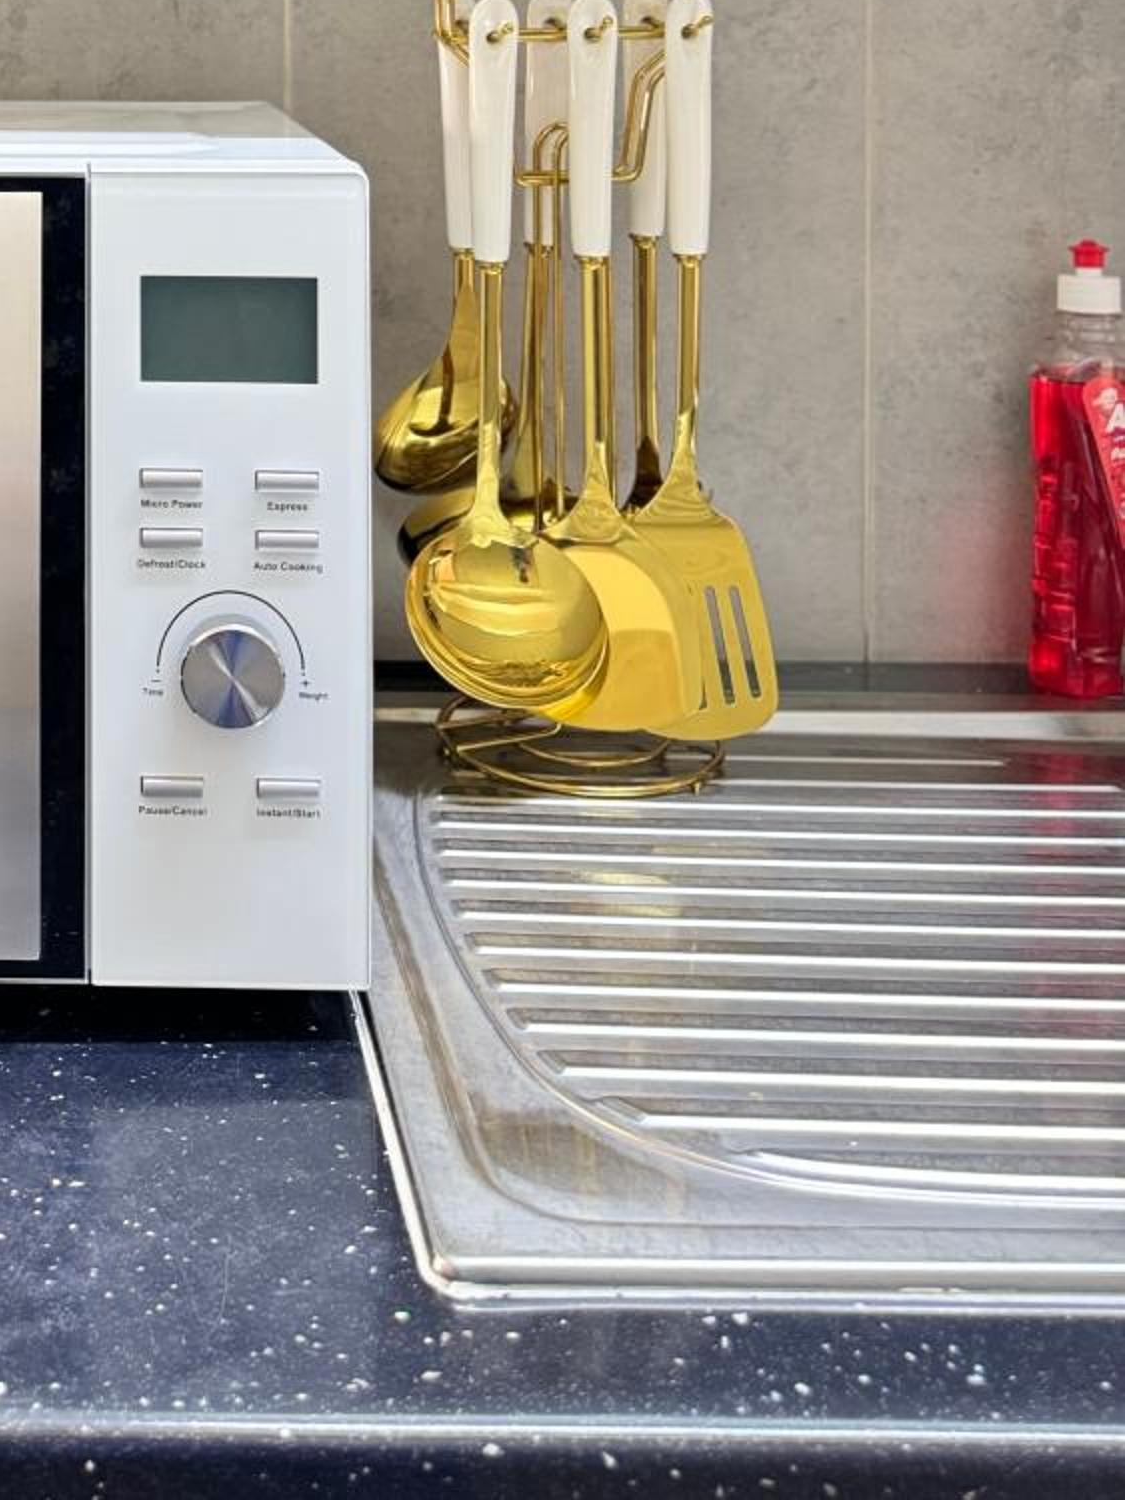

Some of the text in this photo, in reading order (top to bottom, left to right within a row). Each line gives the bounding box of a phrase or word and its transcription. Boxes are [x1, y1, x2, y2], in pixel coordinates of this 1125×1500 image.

[140, 499, 203, 510] Micro Power
[267, 502, 308, 512] Express
[253, 561, 323, 574] Auto Cooking
